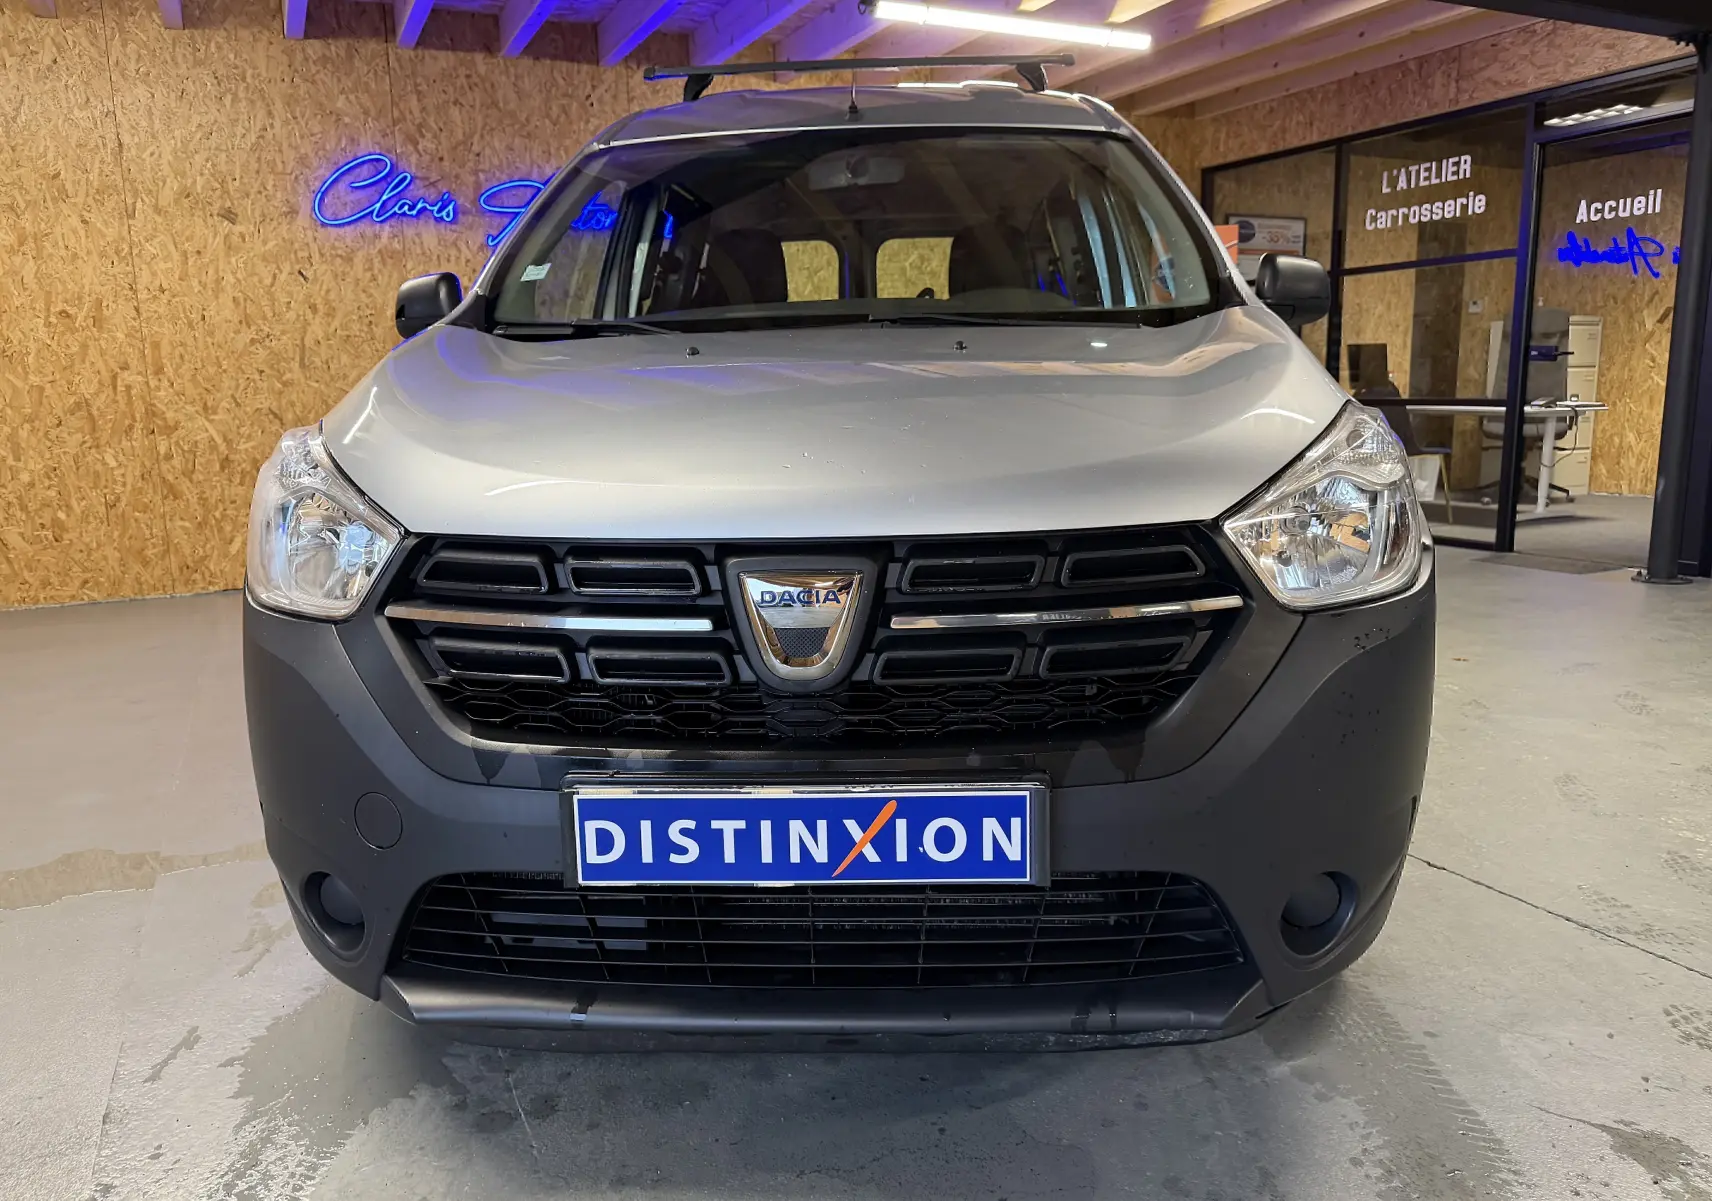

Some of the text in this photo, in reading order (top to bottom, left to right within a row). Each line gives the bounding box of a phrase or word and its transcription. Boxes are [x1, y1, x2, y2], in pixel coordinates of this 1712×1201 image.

[313, 154, 457, 226] Claris
[1381, 154, 1472, 194] L'ATELIER
[1365, 191, 1487, 230] Carrosserie
[1575, 188, 1663, 224] Accueil
[760, 589, 842, 605] DACIA
[583, 803, 1023, 874] DISTINXION
